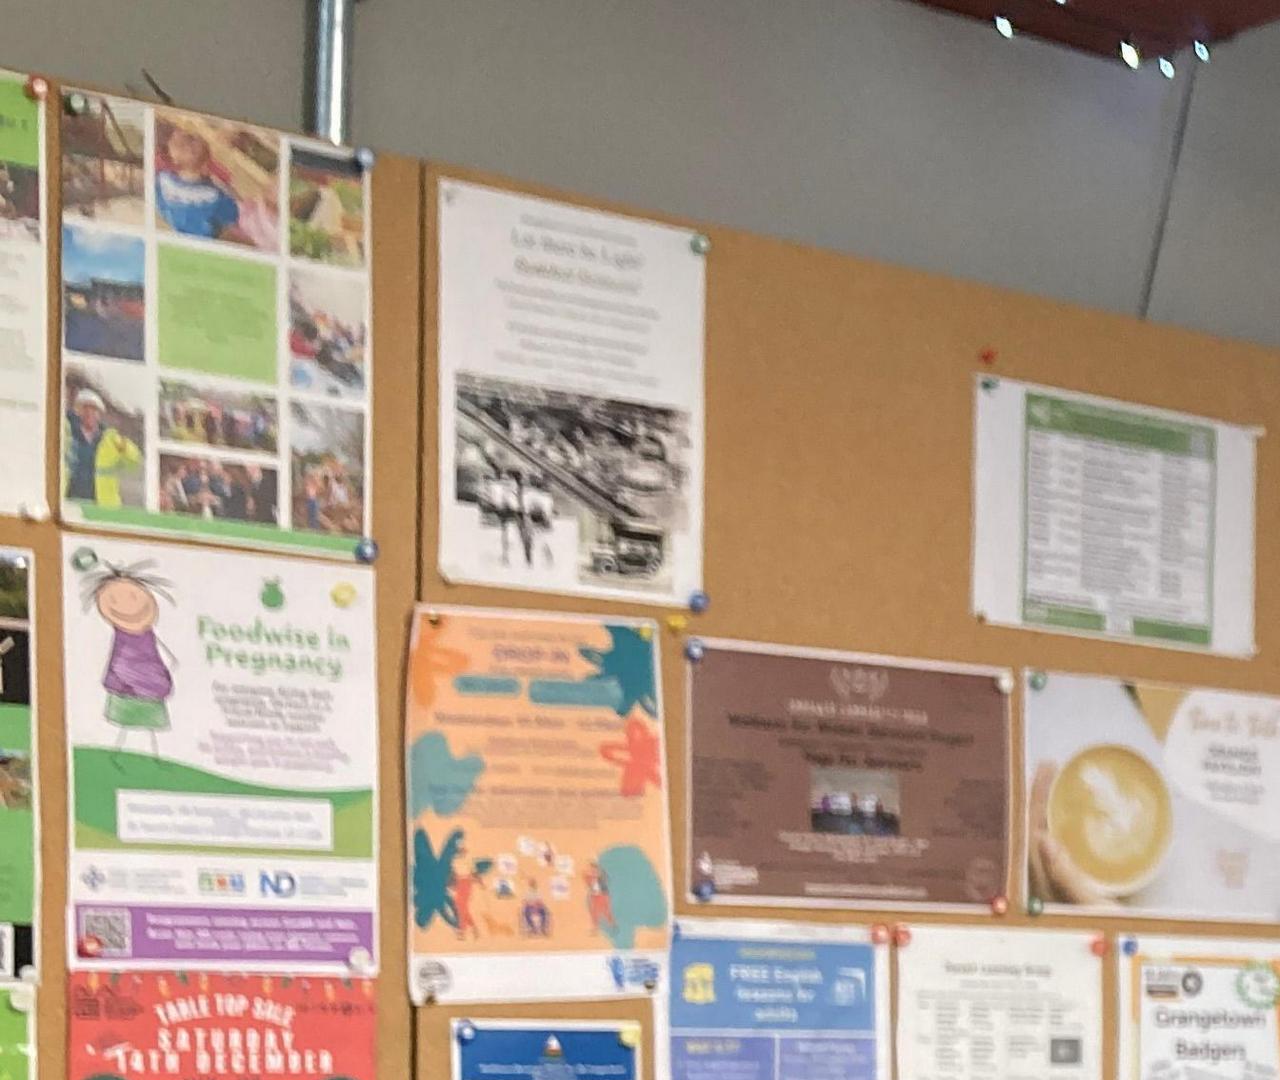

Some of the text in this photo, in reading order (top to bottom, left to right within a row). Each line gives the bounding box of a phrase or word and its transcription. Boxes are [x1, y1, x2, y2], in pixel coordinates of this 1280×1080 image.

[197, 615, 351, 650] Foodwise in
[206, 642, 343, 682] Pregnancy
[728, 963, 770, 981] FREE
[155, 992, 297, 1028] TABLE TOP SALE
[1155, 1005, 1268, 1032] Grangetown
[157, 1027, 295, 1051] SATURDAY
[1175, 1038, 1248, 1065] Badgers
[196, 1048, 334, 1075] DECEMBER
